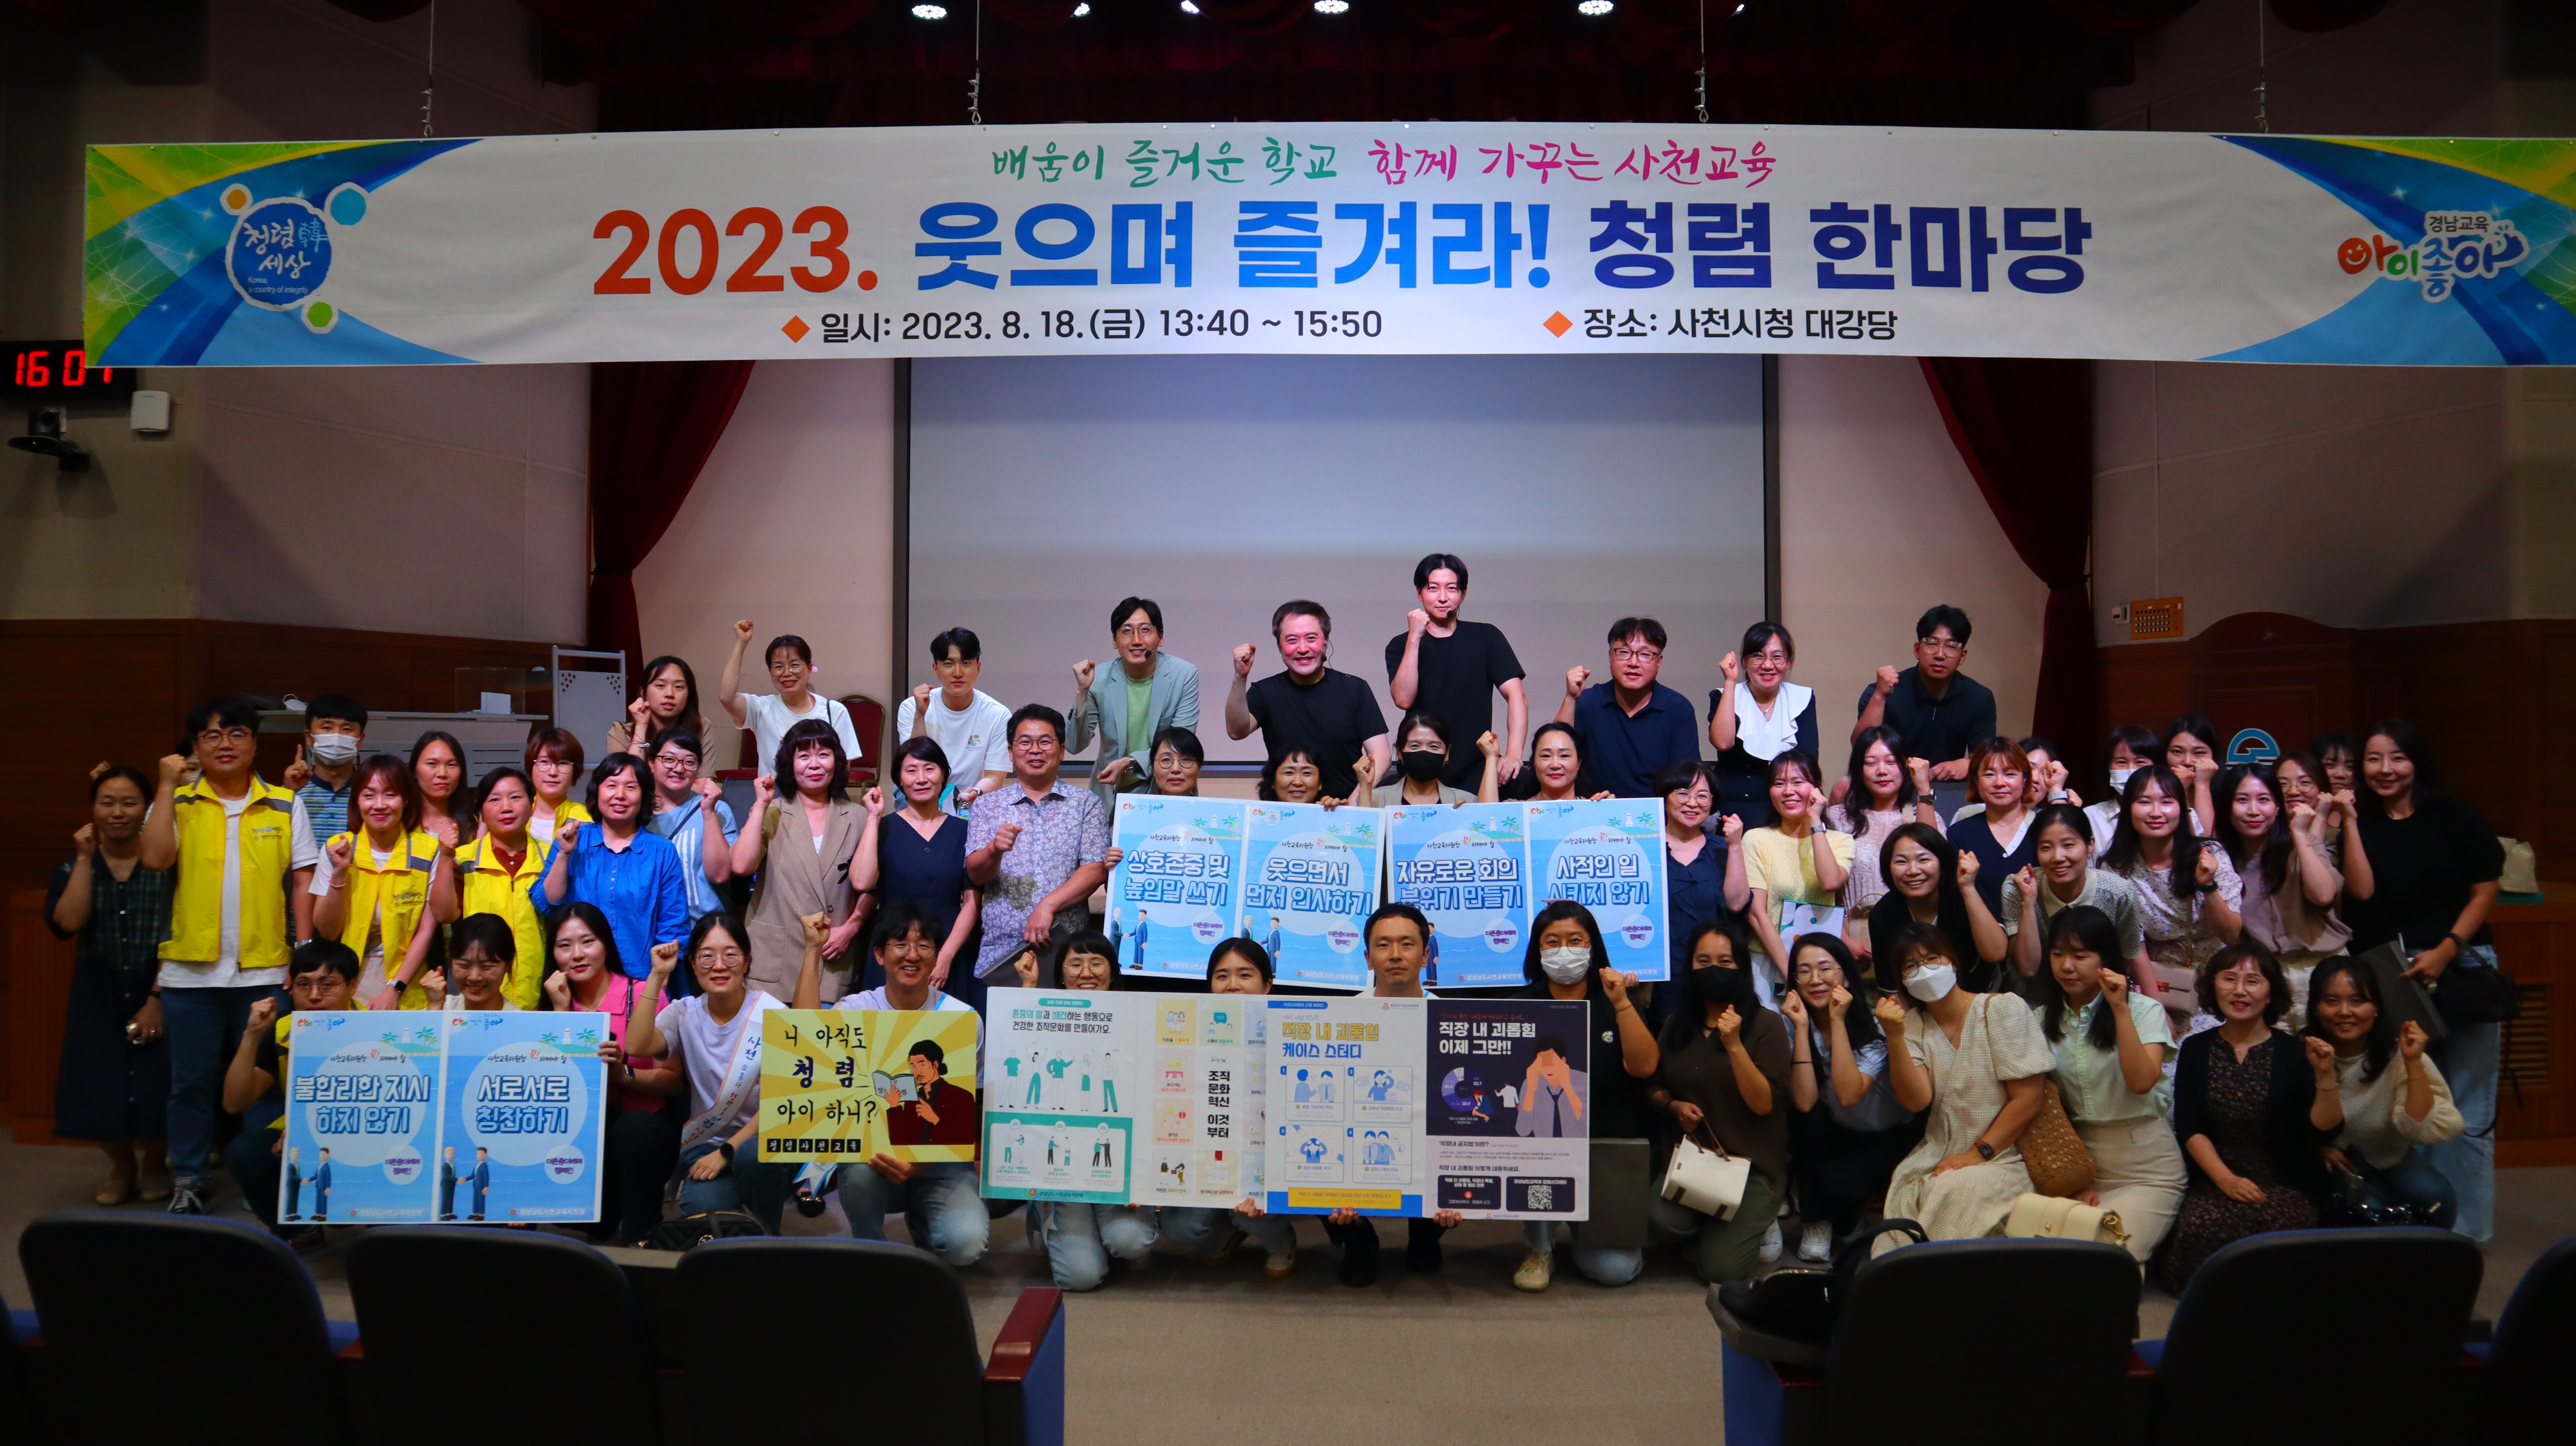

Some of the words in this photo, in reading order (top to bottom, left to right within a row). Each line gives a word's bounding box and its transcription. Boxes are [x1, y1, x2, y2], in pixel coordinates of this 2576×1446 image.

[992, 141, 1103, 182] 배움이
[1126, 140, 1244, 188] 즐거운
[1262, 137, 1337, 186] 학교
[1368, 140, 1457, 185] 함께
[1479, 142, 1603, 184] 가꾸는
[1614, 140, 1776, 188] 사천교육
[243, 218, 295, 255] 청렴
[2429, 216, 2490, 233] 경남교육
[593, 206, 877, 295] 2023.
[915, 201, 1193, 291] 웃으며
[1234, 201, 1549, 289] 즐겨라!
[1589, 201, 1771, 289] 청렴
[1810, 202, 2092, 294] 한마당
[258, 250, 311, 279] 세상
[821, 313, 890, 343] 일시:
[903, 311, 990, 340] 2023.
[1002, 311, 1029, 339] 8.
[1160, 310, 1248, 337] 13:40
[1295, 310, 1381, 337] 15:50
[1585, 309, 1657, 339] 장소:
[1668, 308, 1793, 338] 사천시청
[1806, 309, 1898, 340] 대강당
[1127, 850, 1205, 877] 상호존중
[1209, 854, 1230, 879] 및
[1267, 857, 1349, 887] 웃으면서
[1396, 859, 1475, 884] 자유로운
[1478, 858, 1519, 881] 회의
[1556, 855, 1615, 880] 사적인
[1618, 854, 1639, 878] 일
[1124, 877, 1185, 903] 높임말
[1185, 881, 1228, 907] 쓰기
[1245, 883, 1287, 910] 먼저
[1291, 887, 1373, 916] 인사하기
[1463, 885, 1523, 910] 만들기
[1549, 882, 1607, 906] 시키지
[1610, 881, 1650, 905] 않기
[1012, 1009, 1034, 1019] 존중의
[1036, 1010, 1050, 1020] 말과
[1052, 1011, 1081, 1021] 배려하는
[1084, 1012, 1113, 1022] 행동으로
[1012, 1021, 1034, 1030] 건강한
[1036, 1022, 1072, 1033] 조직문화를
[1074, 1024, 1112, 1034] 만들어가요.
[784, 1024, 798, 1048] 니
[816, 1024, 867, 1049] 아직도
[1282, 1022, 1311, 1040] 직장
[1316, 1023, 1331, 1040] 내
[1336, 1023, 1379, 1041] 괴롭힘
[1439, 1021, 1470, 1037] 직장
[1473, 1022, 1488, 1037] 내
[1491, 1022, 1536, 1038] 괴롭힘
[1282, 1042, 1320, 1058] 케이스
[1324, 1044, 1362, 1059] 스터디
[1439, 1039, 1469, 1054] 이제
[1472, 1040, 1512, 1055] 그만!!
[295, 1074, 382, 1103] 불합리한
[384, 1075, 431, 1103] 지시
[477, 1075, 570, 1103] 서로서로
[1208, 1070, 1230, 1082] 조직
[1208, 1083, 1231, 1095] 문화
[777, 1099, 813, 1125] 아이
[825, 1099, 876, 1125] 하니?
[1208, 1096, 1230, 1108] 혁신
[316, 1106, 361, 1134] 하지
[365, 1106, 410, 1134] 않기
[476, 1106, 568, 1134] 칭찬하기
[1207, 1114, 1230, 1125] 이것
[1207, 1127, 1229, 1138] 부터
